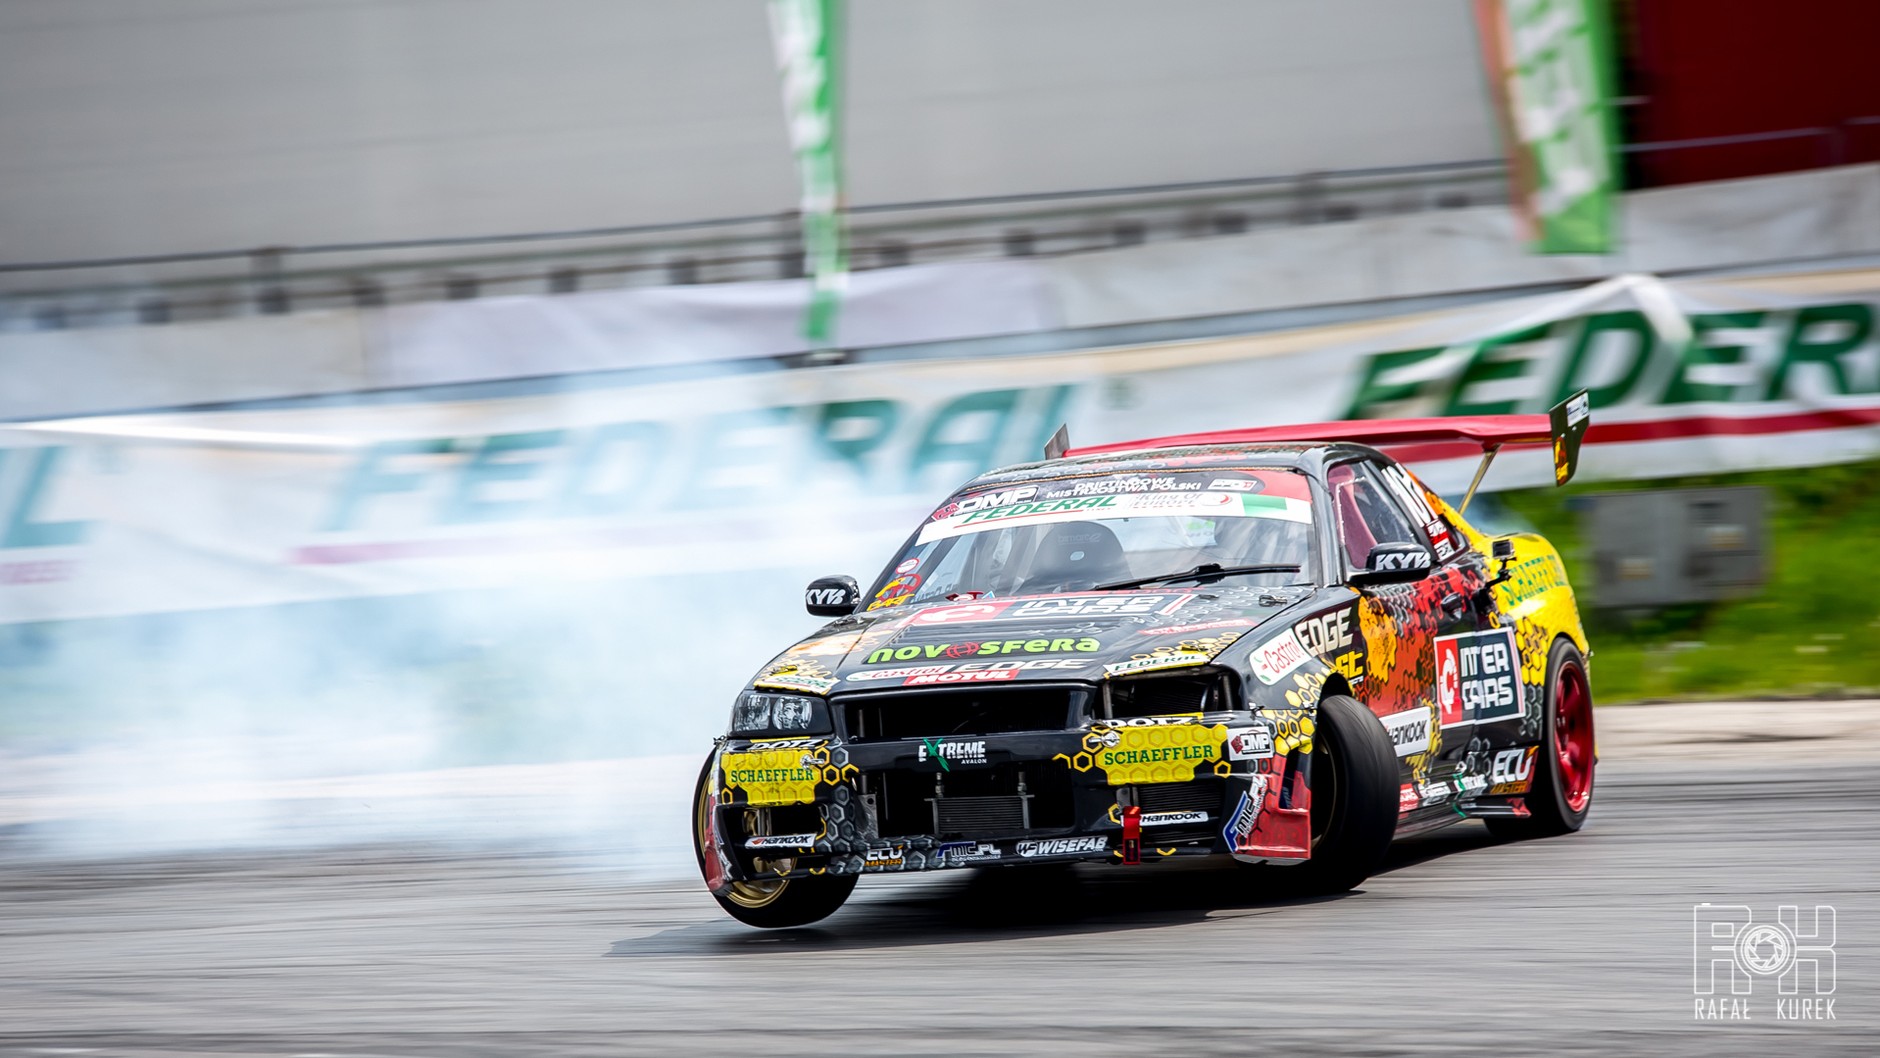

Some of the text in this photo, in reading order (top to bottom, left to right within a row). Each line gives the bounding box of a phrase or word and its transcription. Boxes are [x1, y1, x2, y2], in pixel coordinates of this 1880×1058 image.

[1336, 303, 1880, 420] FEDER
[1046, 482, 1148, 499] MISTRZOSTWA
[1150, 482, 1202, 491] POLSKI
[962, 496, 1117, 524] FEDERAL
[1375, 552, 1431, 571] KYB
[805, 588, 846, 605] KYB
[1264, 607, 1354, 674] Castrol EDGE
[954, 659, 1095, 673] EDGE
[1460, 642, 1510, 677] INTER
[911, 671, 1012, 685] MOTUL
[1461, 675, 1514, 710] CARS
[1103, 717, 1192, 727] DOTZ
[750, 739, 823, 749] DOTZ
[1241, 735, 1270, 750] DMP
[918, 737, 986, 771] EXTREME
[1104, 744, 1214, 766] SCHAEFFLER
[1492, 748, 1533, 784] ECU
[731, 768, 814, 783] SCHAEFFLER
[866, 847, 903, 861] ECU
[1039, 836, 1108, 854] WISEFAB
